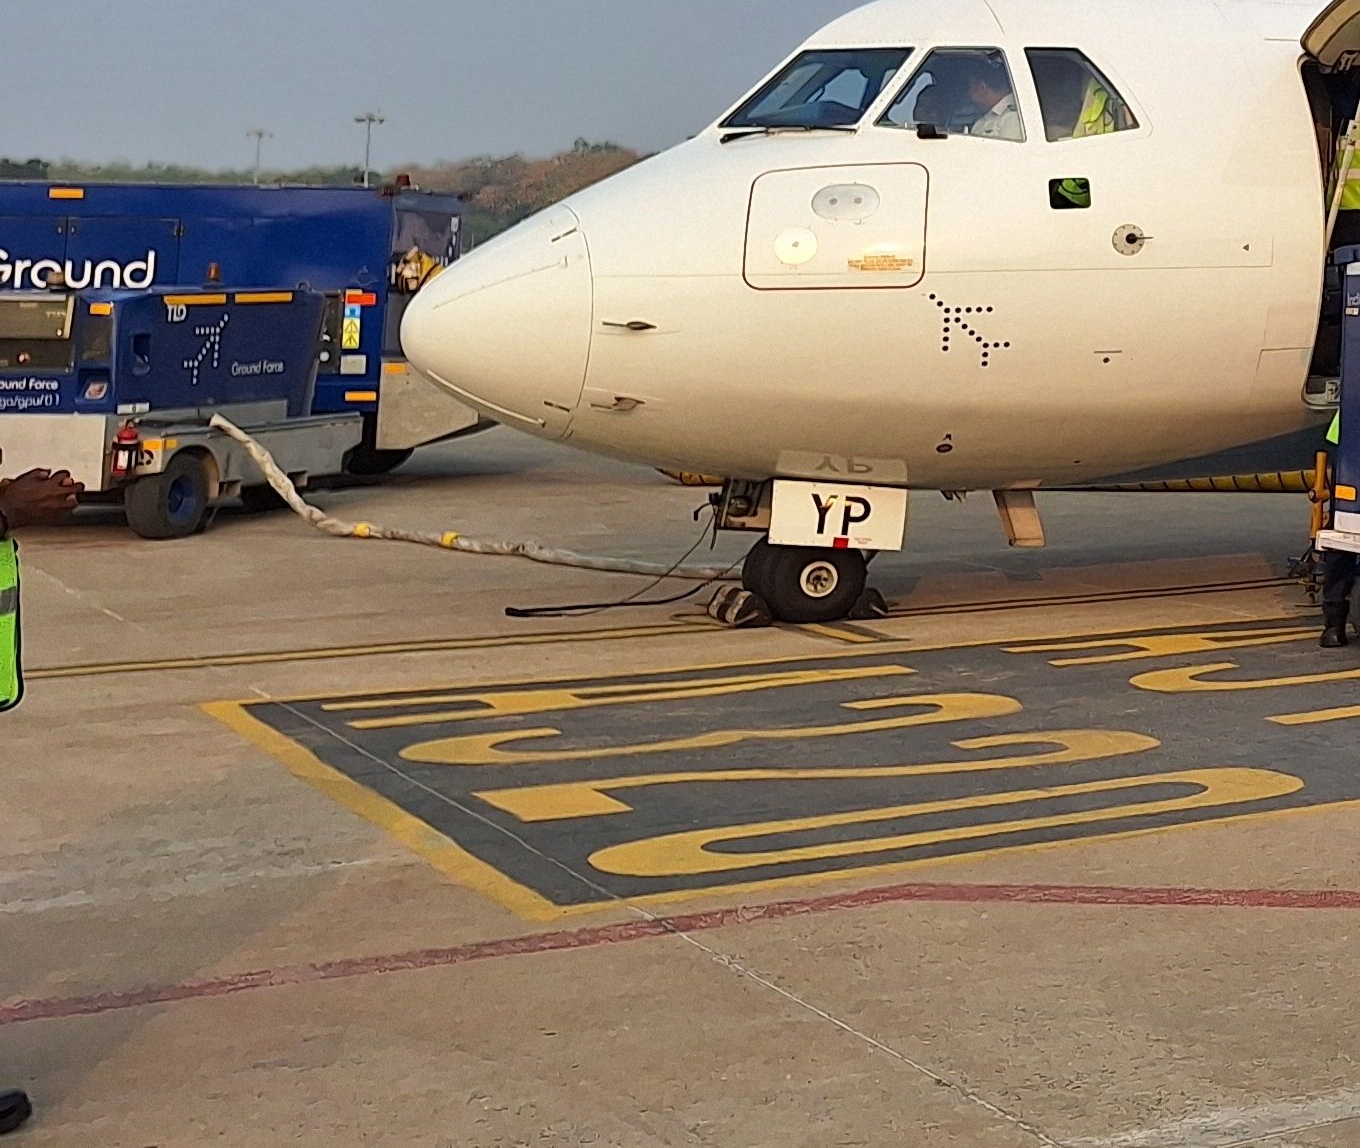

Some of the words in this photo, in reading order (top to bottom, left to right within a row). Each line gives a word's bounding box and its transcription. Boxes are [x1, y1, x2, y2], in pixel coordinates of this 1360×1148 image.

[231, 361, 262, 376] Ground
[262, 360, 284, 372] Force
[0, 377, 26, 390] ound
[29, 377, 59, 390] Force
[811, 493, 872, 536] YP
